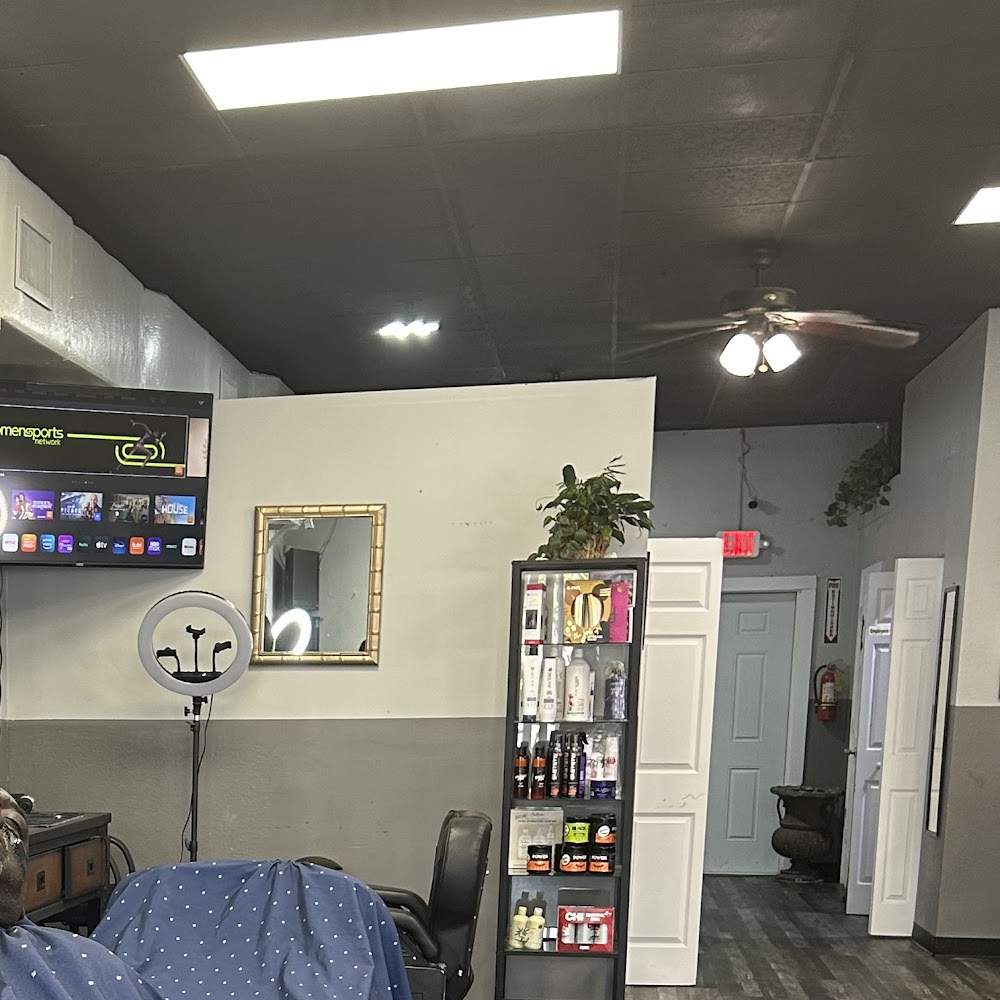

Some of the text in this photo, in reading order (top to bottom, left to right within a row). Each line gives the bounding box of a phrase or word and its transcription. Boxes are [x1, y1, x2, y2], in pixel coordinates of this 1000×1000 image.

[34, 438, 62, 446] network
[161, 503, 189, 515] HOUSE
[723, 531, 756, 557] EXIT
[564, 912, 585, 922] CHI
